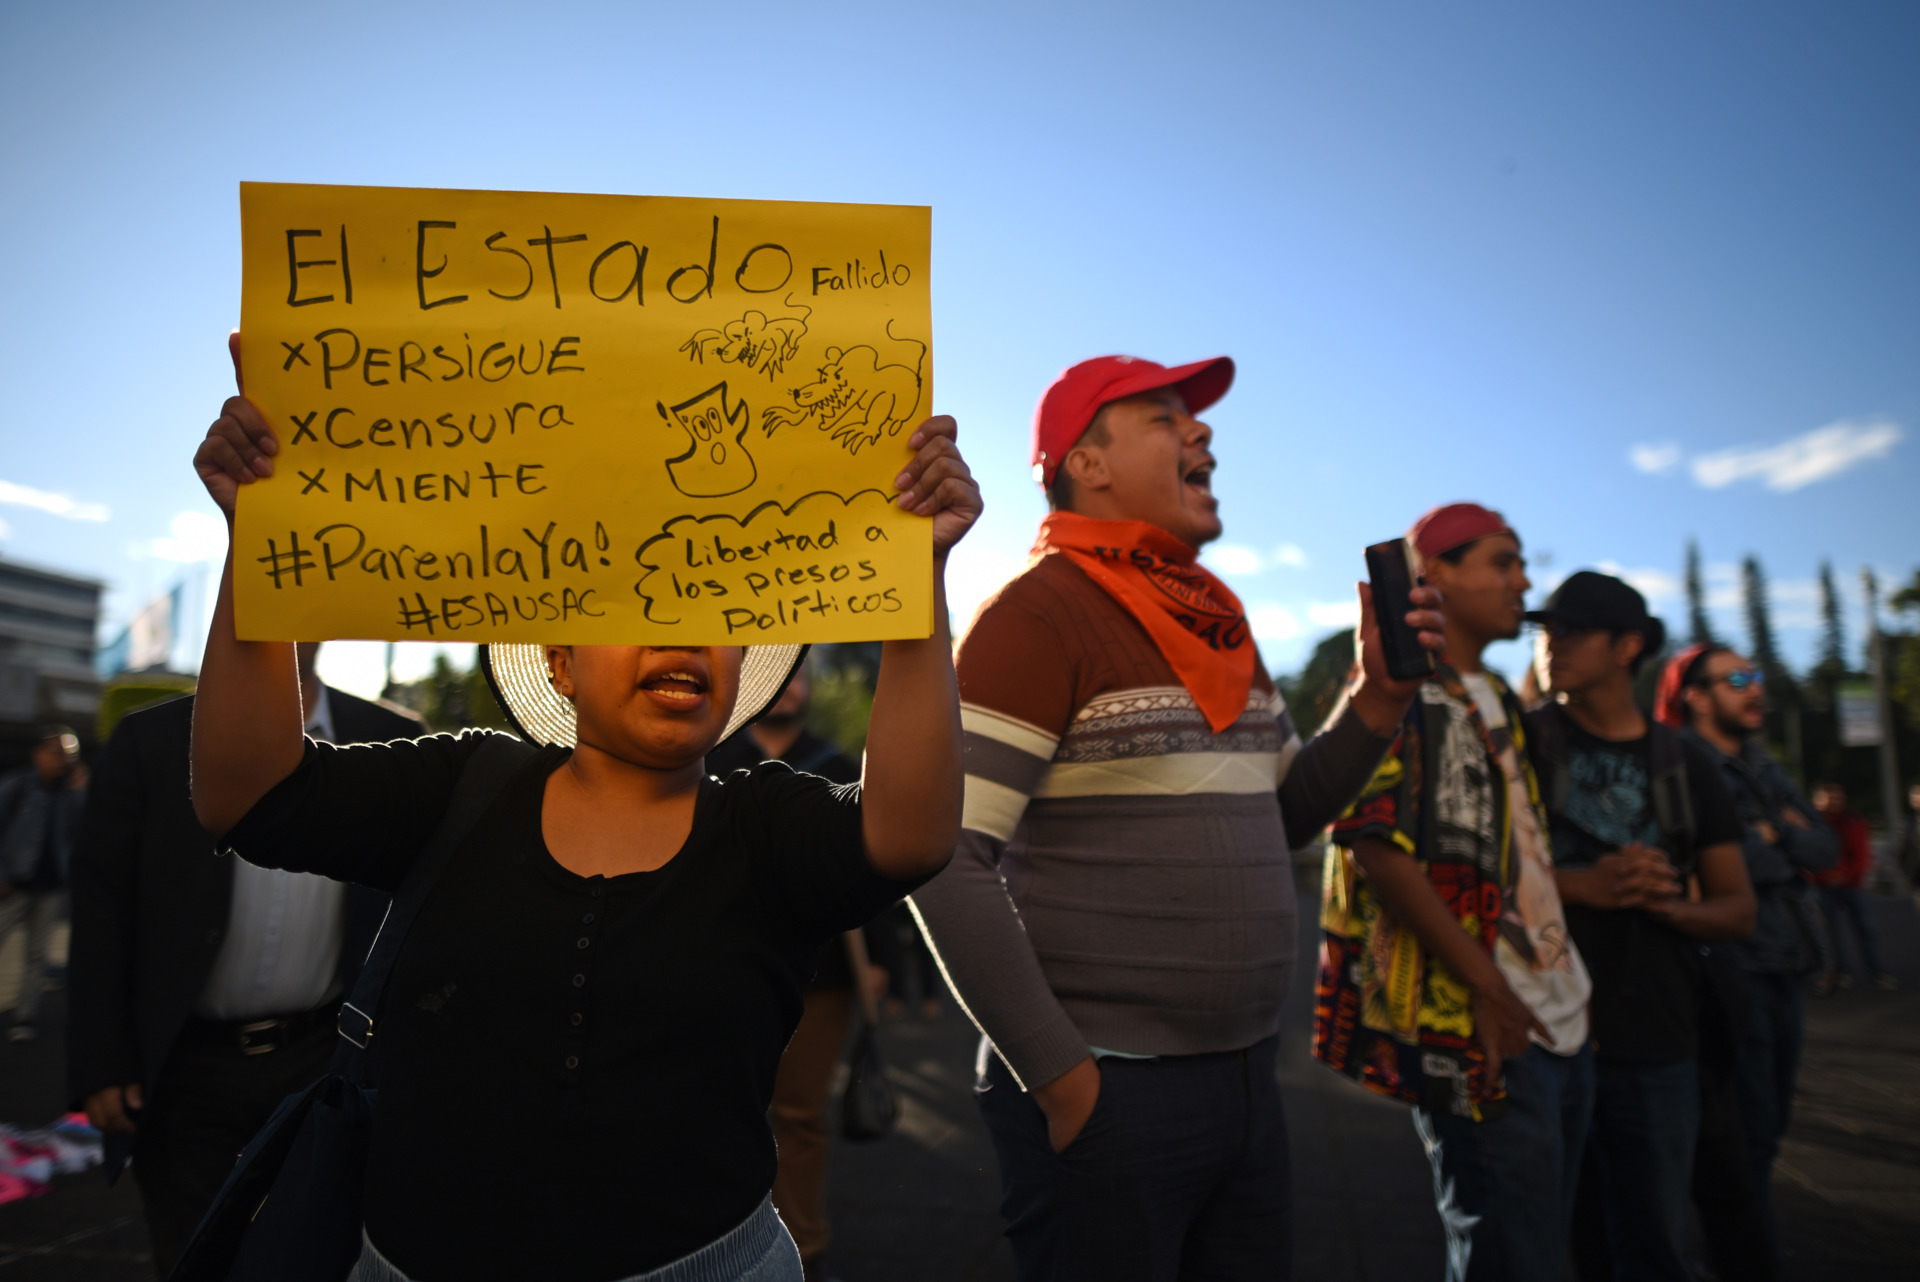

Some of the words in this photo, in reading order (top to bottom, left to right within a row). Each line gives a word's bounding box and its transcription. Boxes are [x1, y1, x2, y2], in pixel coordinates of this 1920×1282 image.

[285, 223, 353, 308] El
[416, 214, 794, 311] Estado
[811, 249, 911, 296] Fallido
[864, 525, 889, 542] a
[672, 572, 729, 599] los
[396, 587, 606, 635] #ESAUSAC
